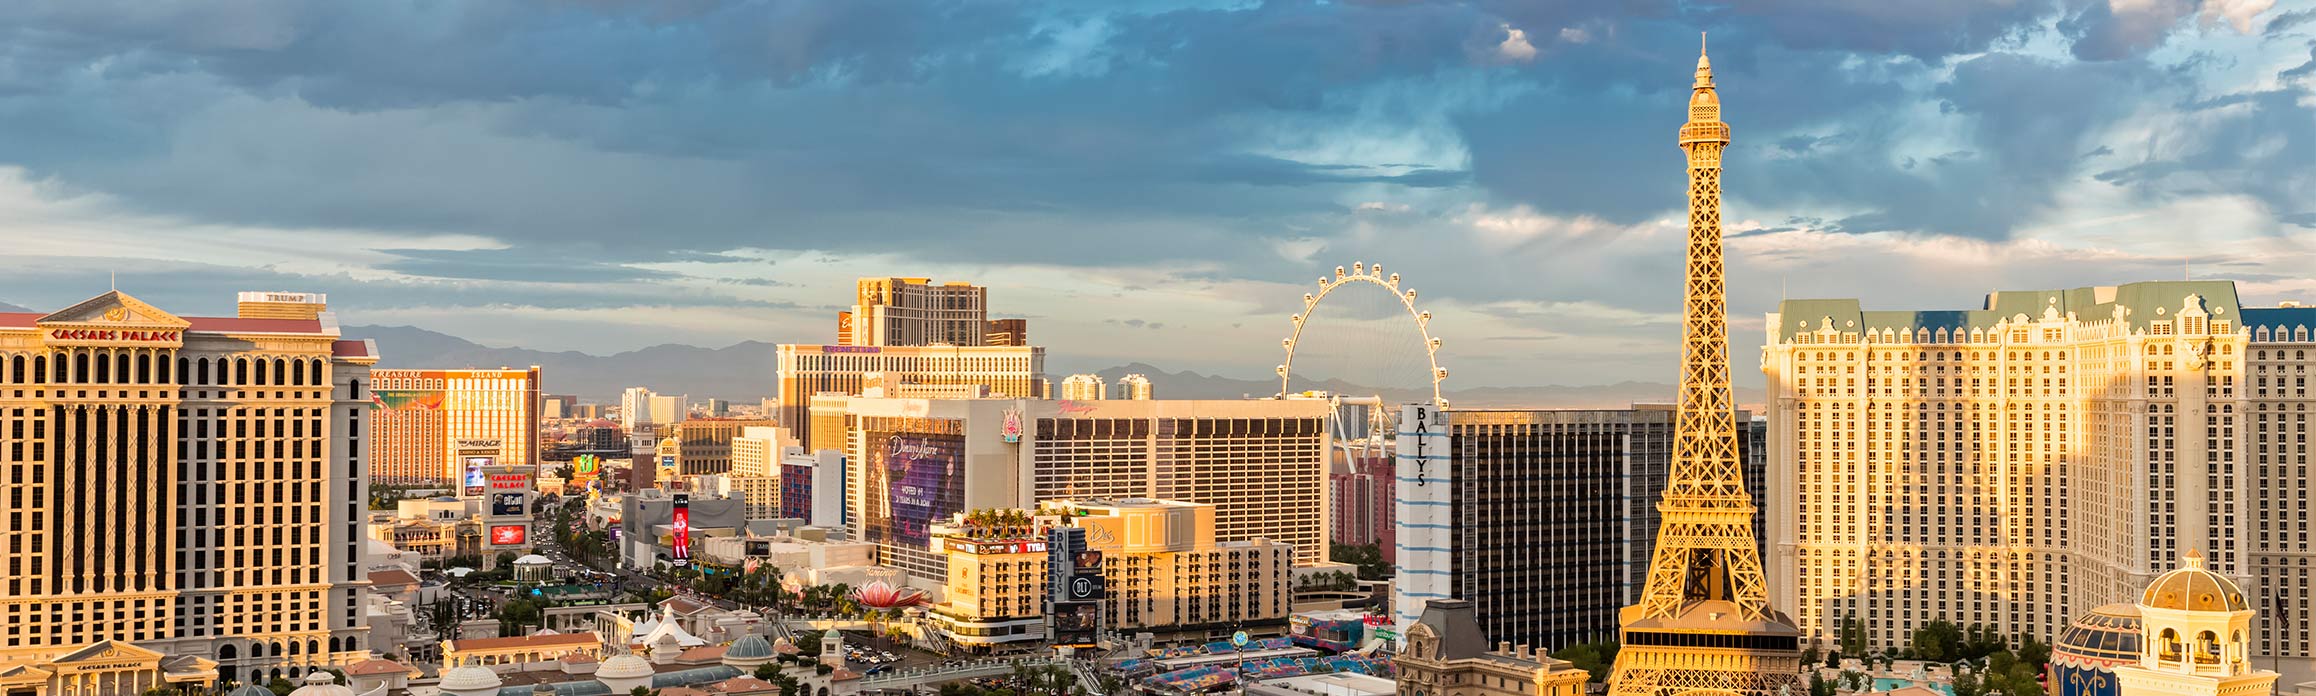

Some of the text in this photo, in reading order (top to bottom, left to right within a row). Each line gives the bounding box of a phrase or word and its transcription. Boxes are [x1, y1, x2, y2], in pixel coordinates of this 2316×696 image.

[266, 294, 304, 302] TRUMP
[51, 328, 178, 342] CAESARS PALACE
[504, 494, 523, 506] elton
[1026, 542, 1046, 552] TYGA
[1076, 581, 1088, 593] BLT
